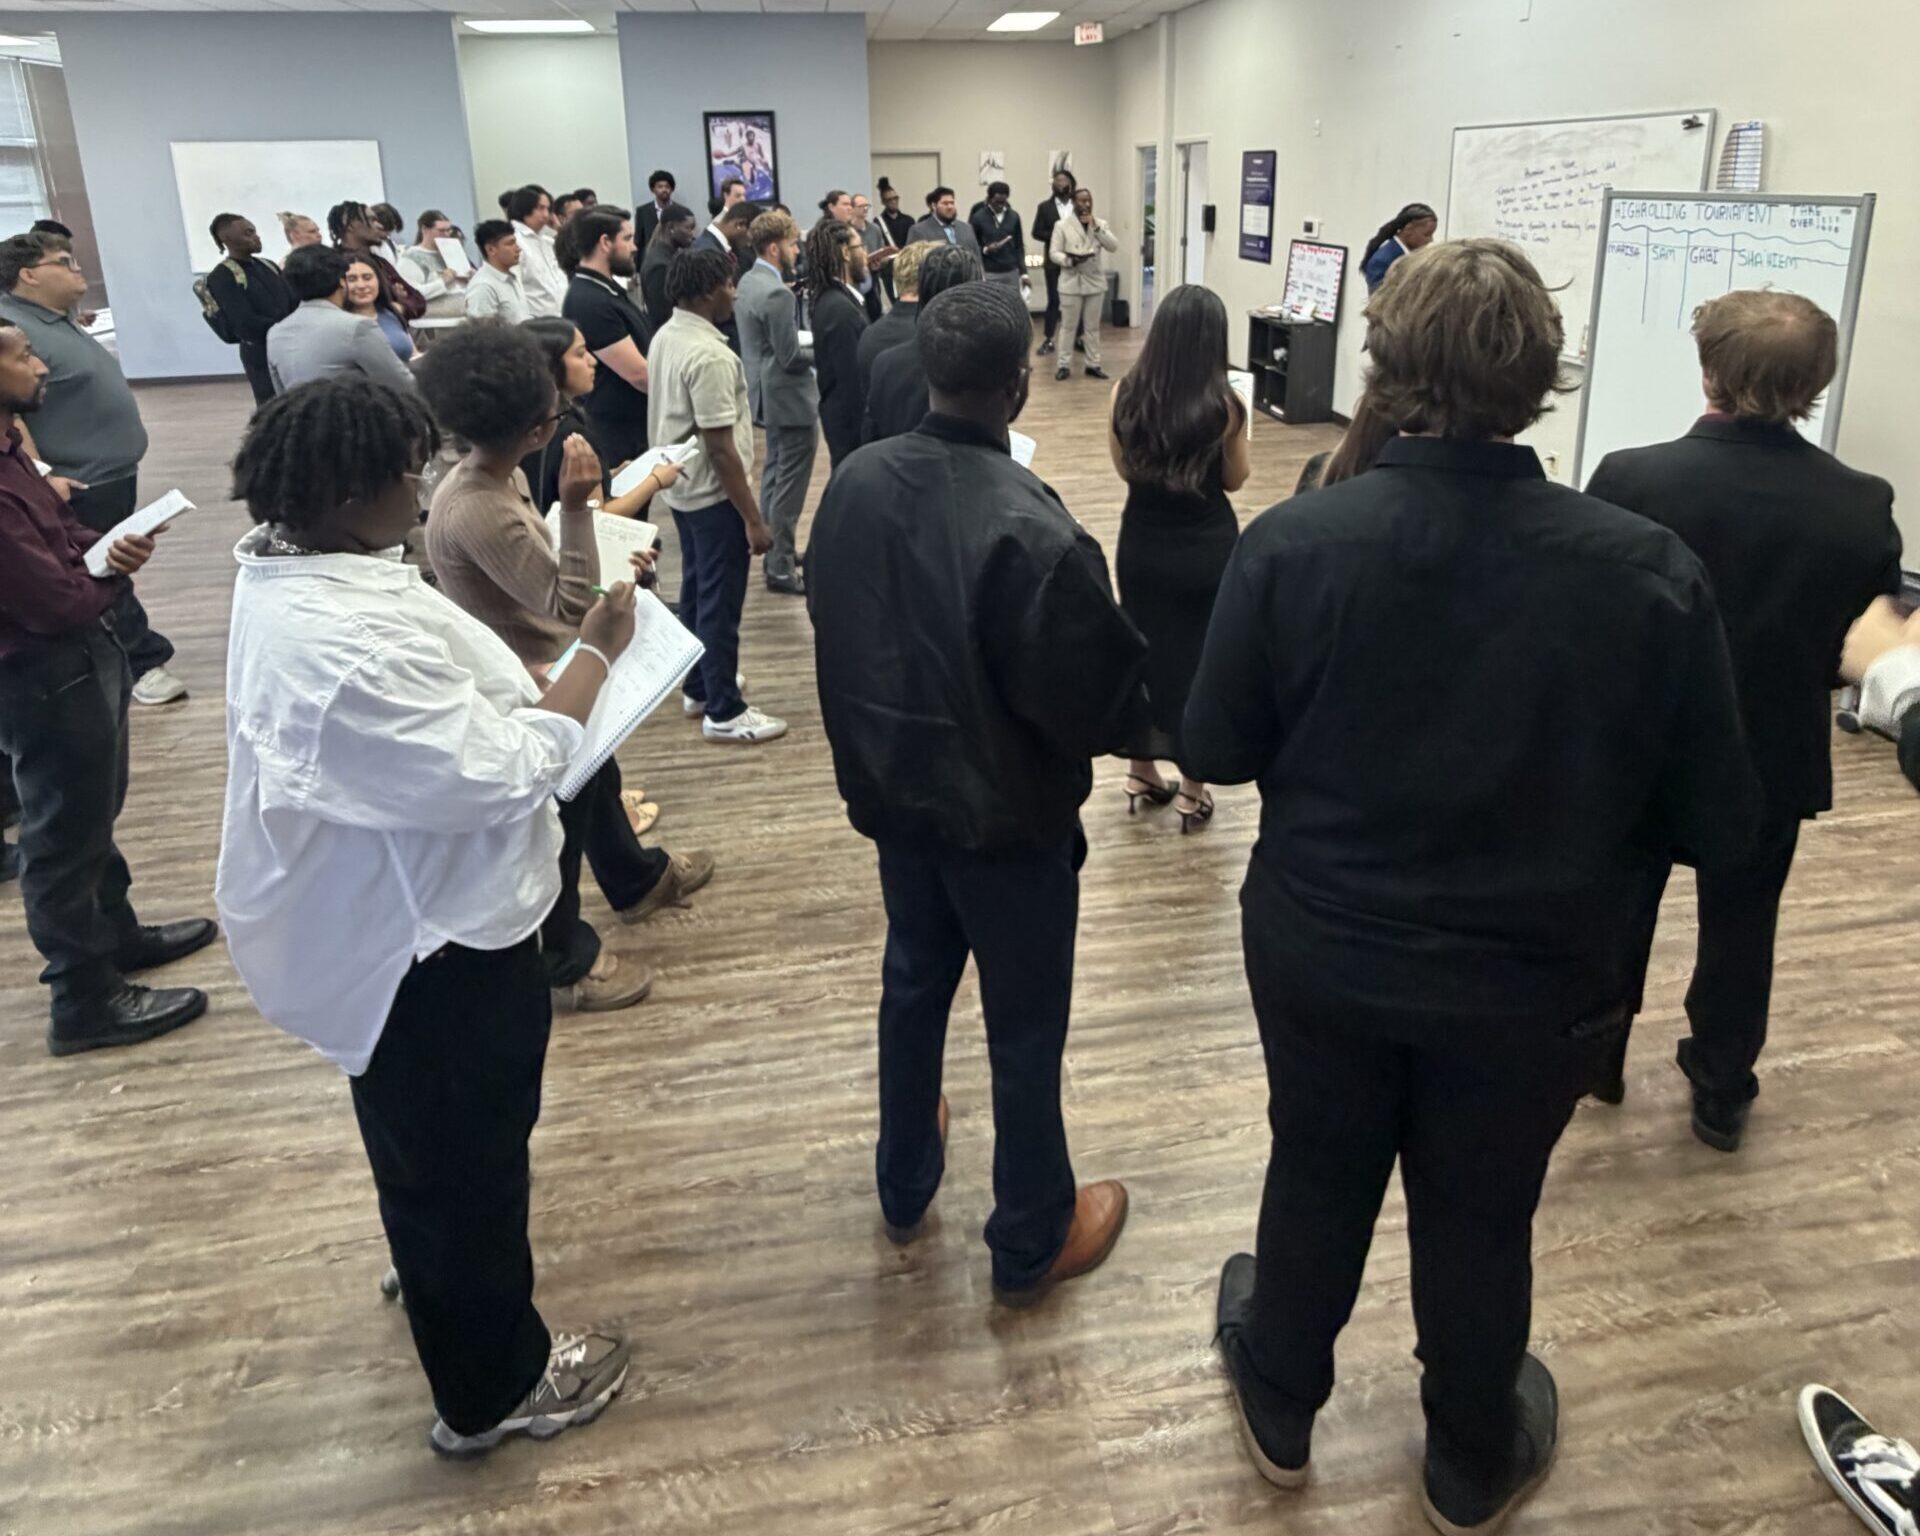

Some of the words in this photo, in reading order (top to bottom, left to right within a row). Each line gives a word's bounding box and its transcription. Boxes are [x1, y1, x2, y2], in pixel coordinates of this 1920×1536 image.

[1695, 203, 1779, 226] TOURNAMENT
[1651, 245, 1677, 263] SAM
[1689, 246, 1720, 264] GABI
